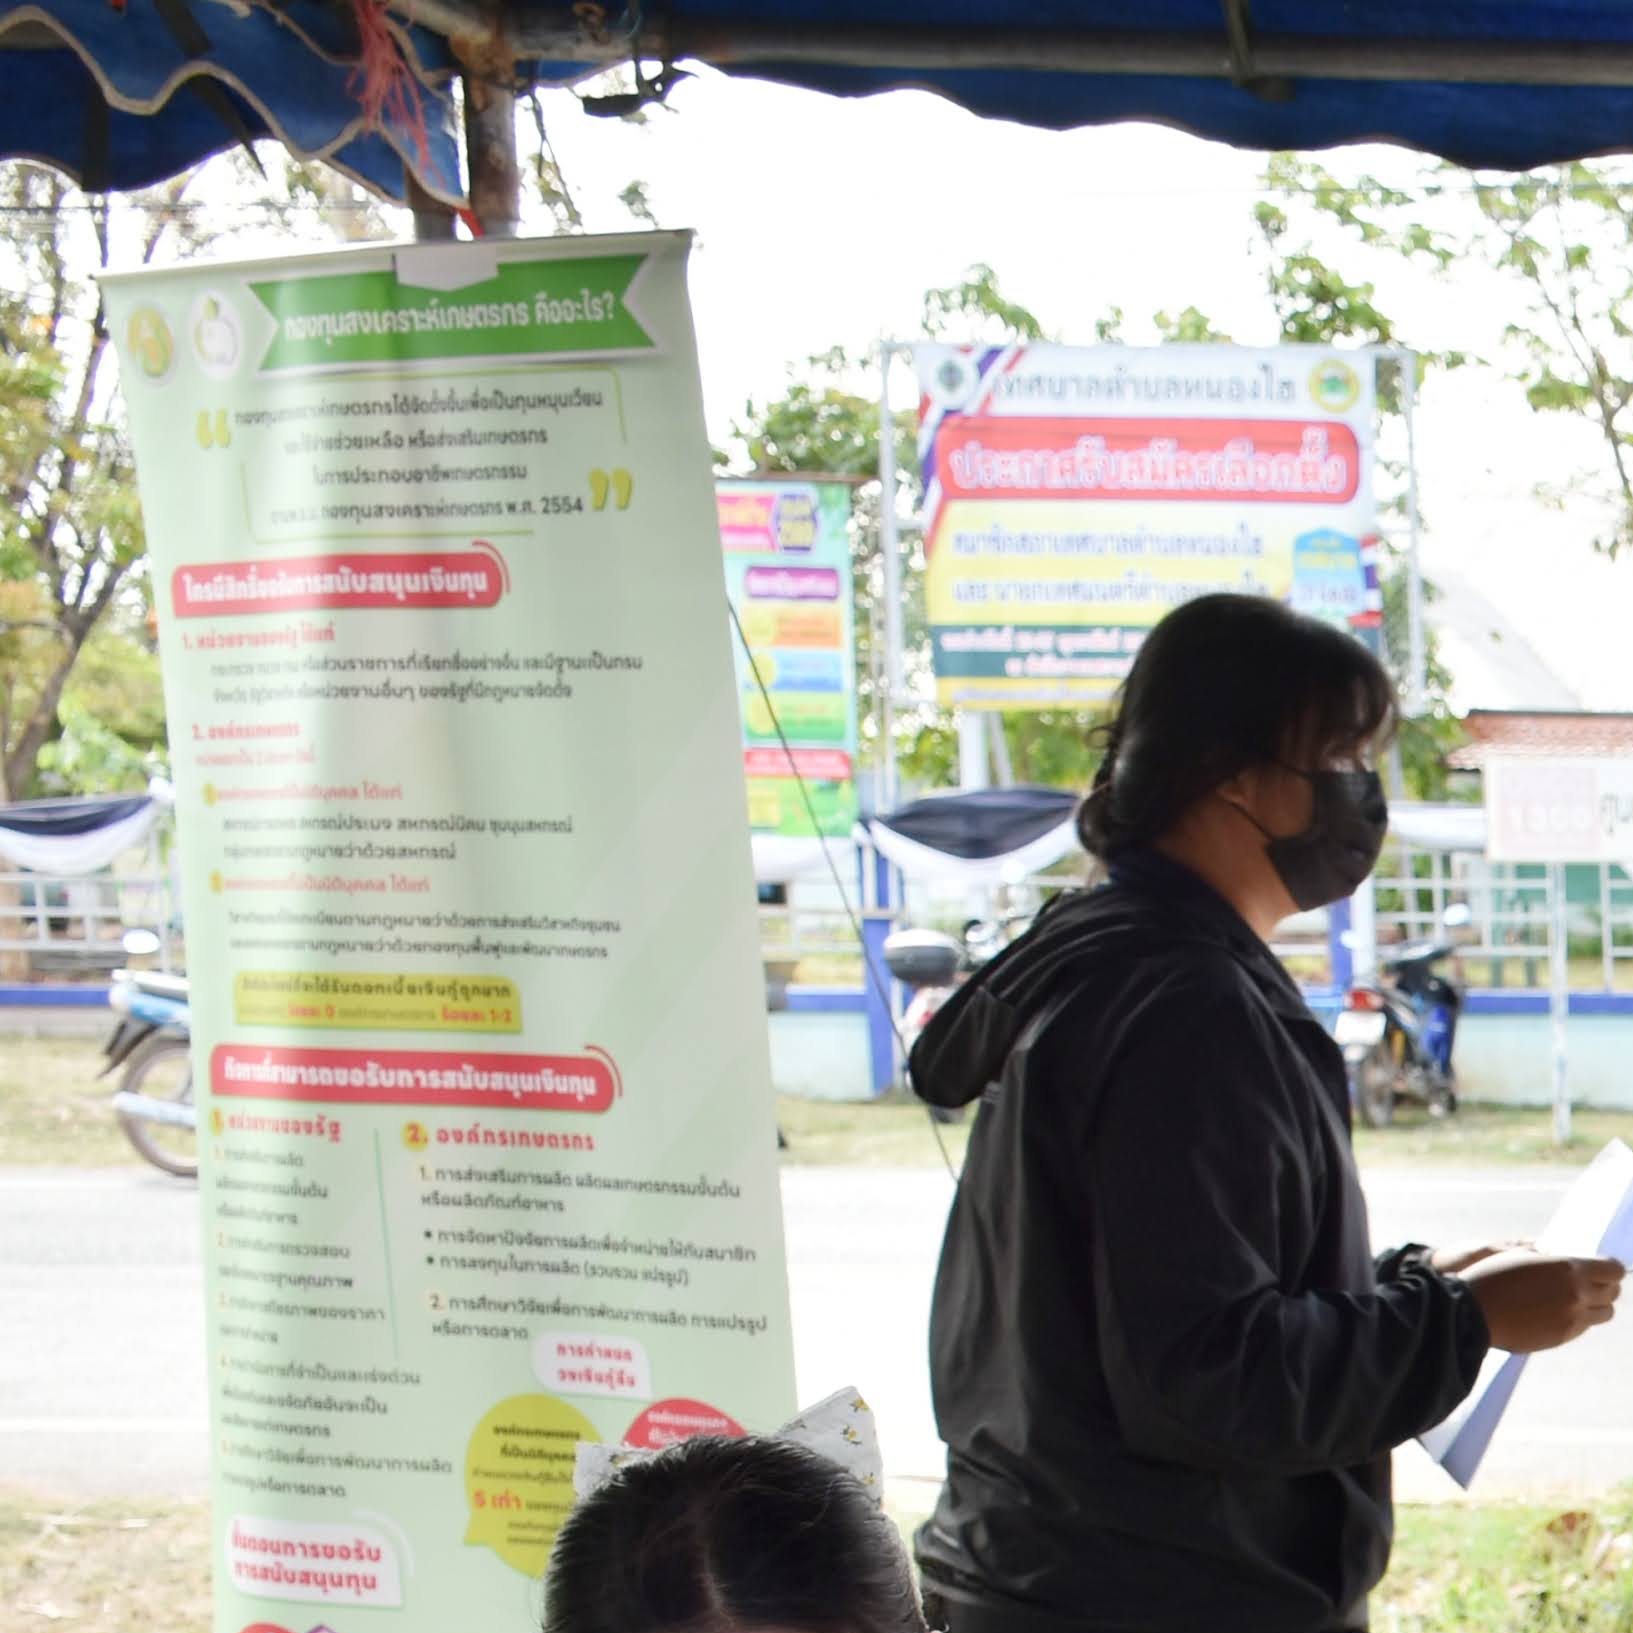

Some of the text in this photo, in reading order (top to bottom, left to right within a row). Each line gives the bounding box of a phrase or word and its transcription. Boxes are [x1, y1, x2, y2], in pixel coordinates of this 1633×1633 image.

[536, 289, 615, 324] คืออะไร?
[540, 497, 584, 514] 2554
[407, 1121, 596, 1152] 2. องค์กรเกษตรกร
[431, 1319, 529, 1341] หรือการตลาด
